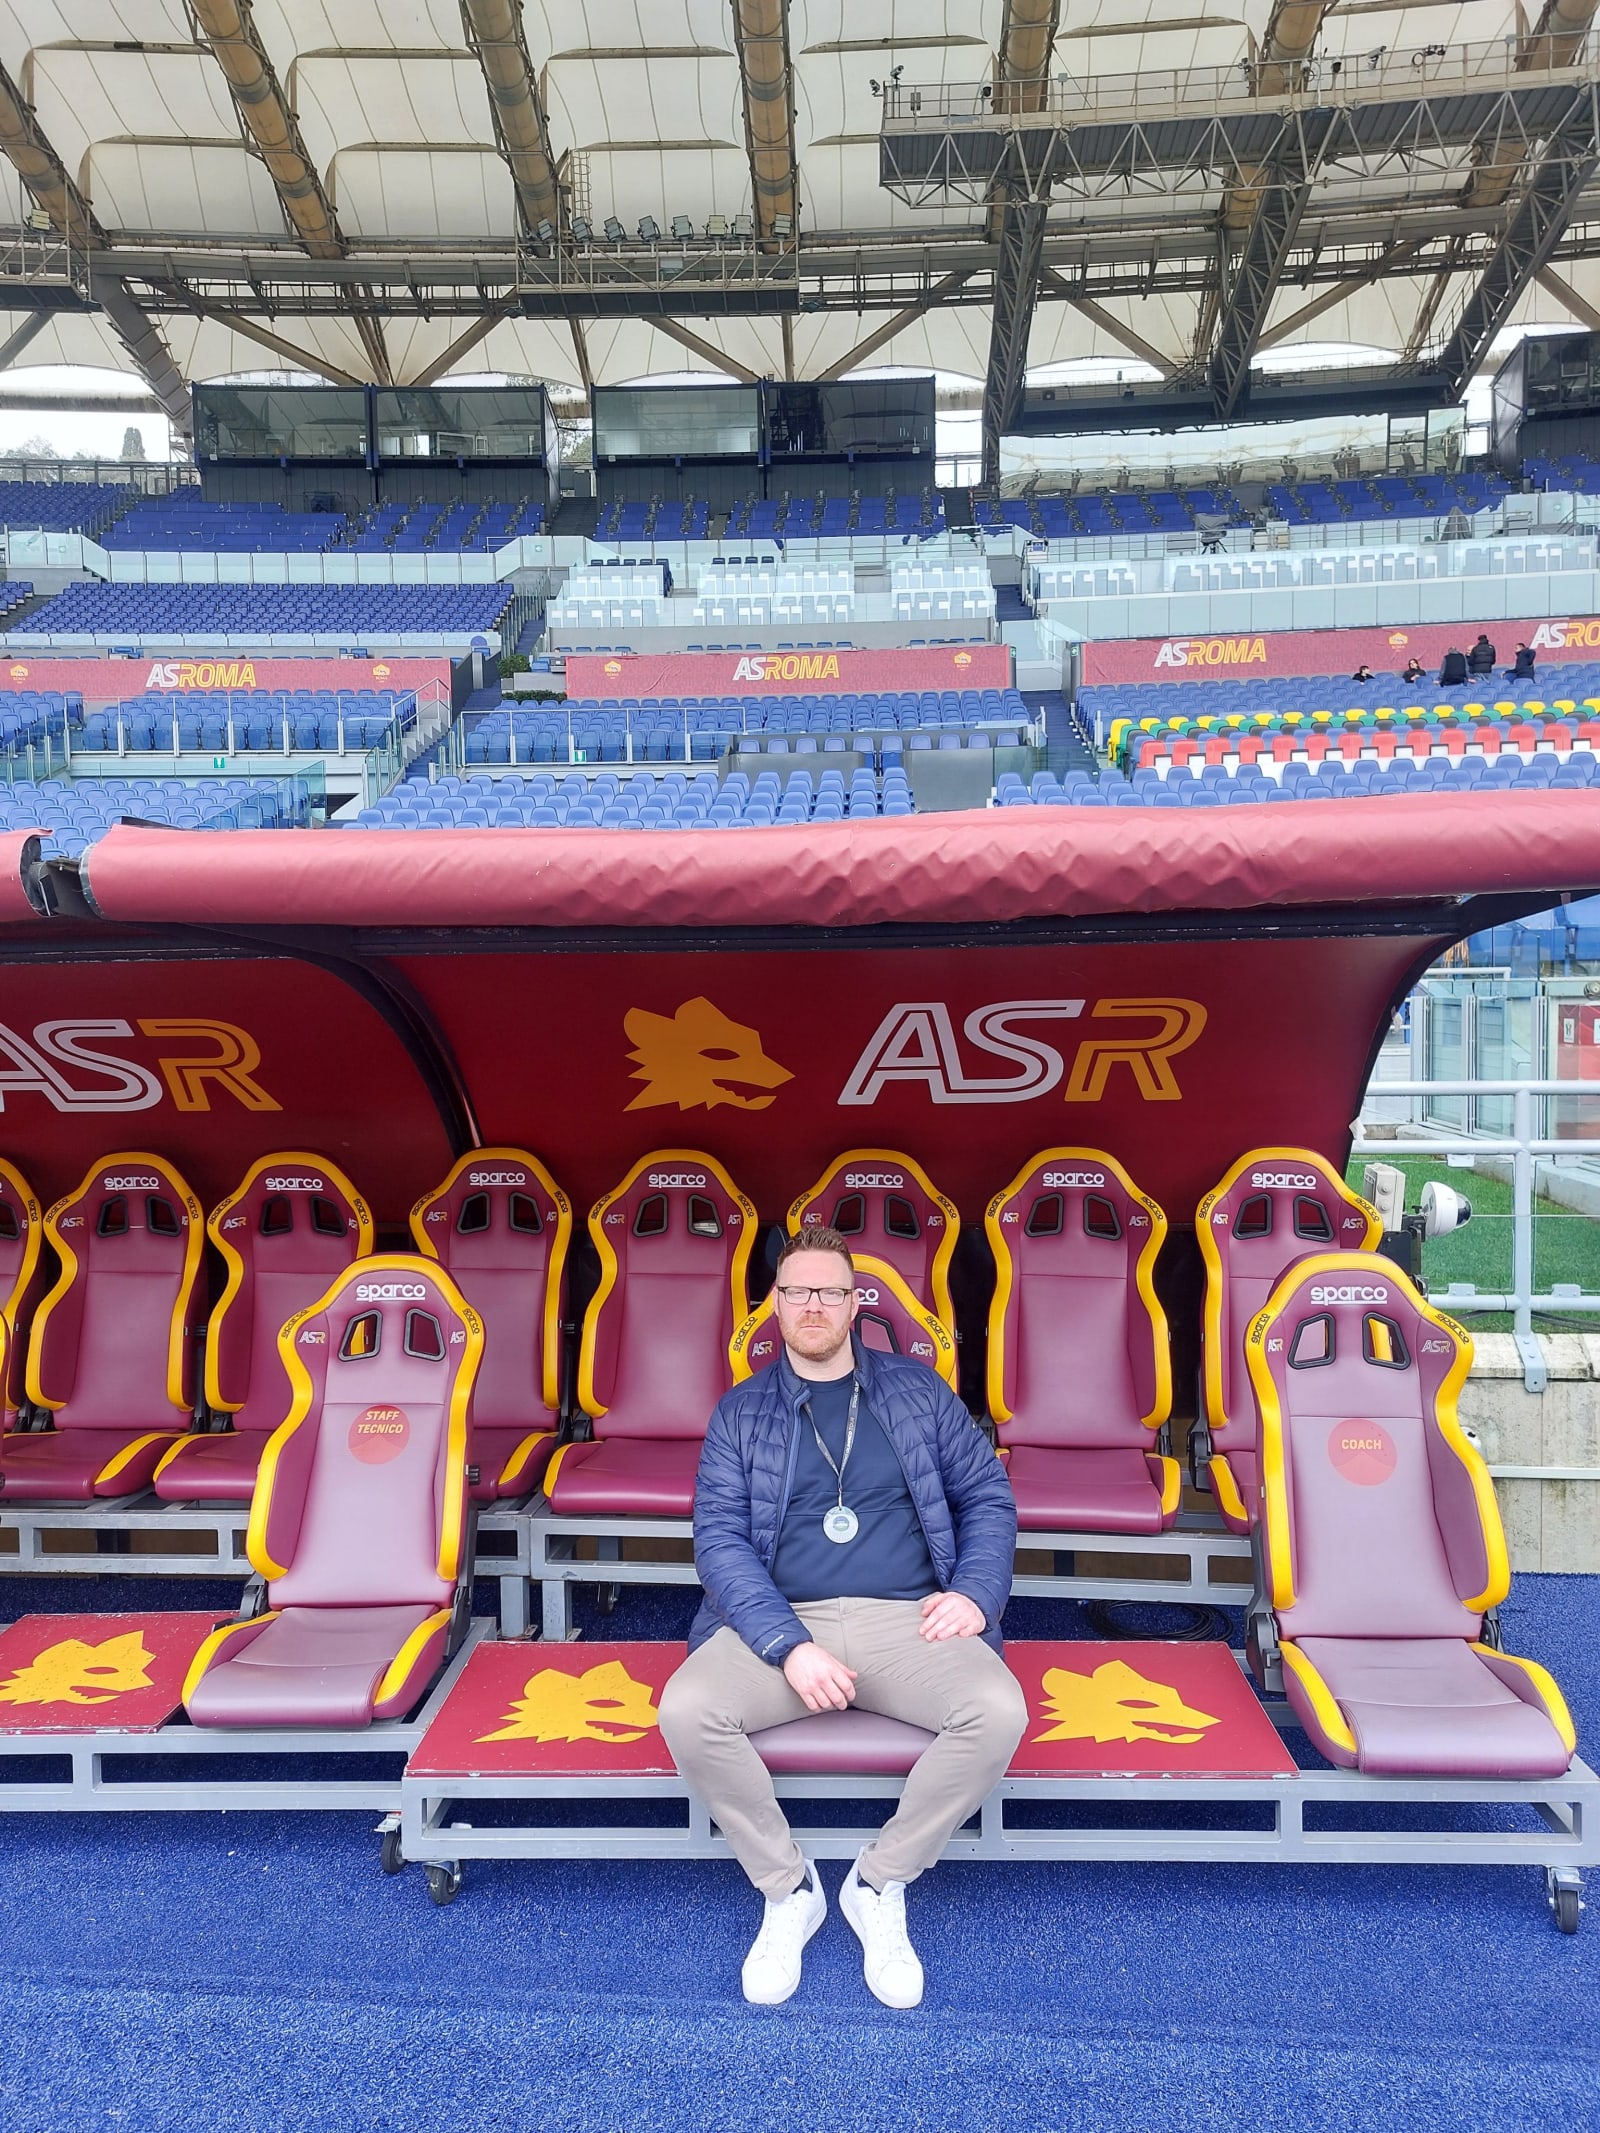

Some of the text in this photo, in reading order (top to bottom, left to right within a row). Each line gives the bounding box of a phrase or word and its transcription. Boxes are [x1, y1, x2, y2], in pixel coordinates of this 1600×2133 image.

[837, 997, 1208, 1105] ASR
[104, 1176, 160, 1191] sparco
[265, 1177, 324, 1191] sparco
[469, 1172, 526, 1186] sparco
[648, 1173, 706, 1188] sparco
[844, 1173, 904, 1189] sparco
[1042, 1172, 1105, 1188] sparco
[1251, 1172, 1317, 1190] sparco
[1198, 1193, 1217, 1220] sparco
[61, 1217, 85, 1229] ASR
[223, 1216, 247, 1230] ASR
[426, 1211, 448, 1222] ASR
[605, 1213, 625, 1225] ASR
[727, 1214, 742, 1225] ASR
[803, 1212, 823, 1224] ASR
[927, 1215, 944, 1227] ASR
[1002, 1212, 1020, 1223] ASR
[1128, 1215, 1149, 1227] ASR
[1213, 1213, 1229, 1225] ASR
[1342, 1217, 1365, 1229] ASR
[356, 1283, 426, 1303] sparco
[1310, 1285, 1388, 1306] sparco
[462, 1307, 481, 1336] sparco
[733, 1315, 758, 1353] sparco
[923, 1315, 951, 1351] sparco
[1251, 1313, 1271, 1345] sparco
[1435, 1313, 1470, 1345] sparco
[299, 1331, 326, 1344] ASR
[450, 1331, 465, 1344] ASR
[751, 1340, 774, 1358] ASR
[910, 1341, 934, 1357] ASR
[1267, 1338, 1284, 1352] ASR
[1421, 1339, 1451, 1353] ASR
[365, 1410, 400, 1421] STAFF
[357, 1423, 404, 1434] TECNICO
[1341, 1439, 1382, 1450] COACH
